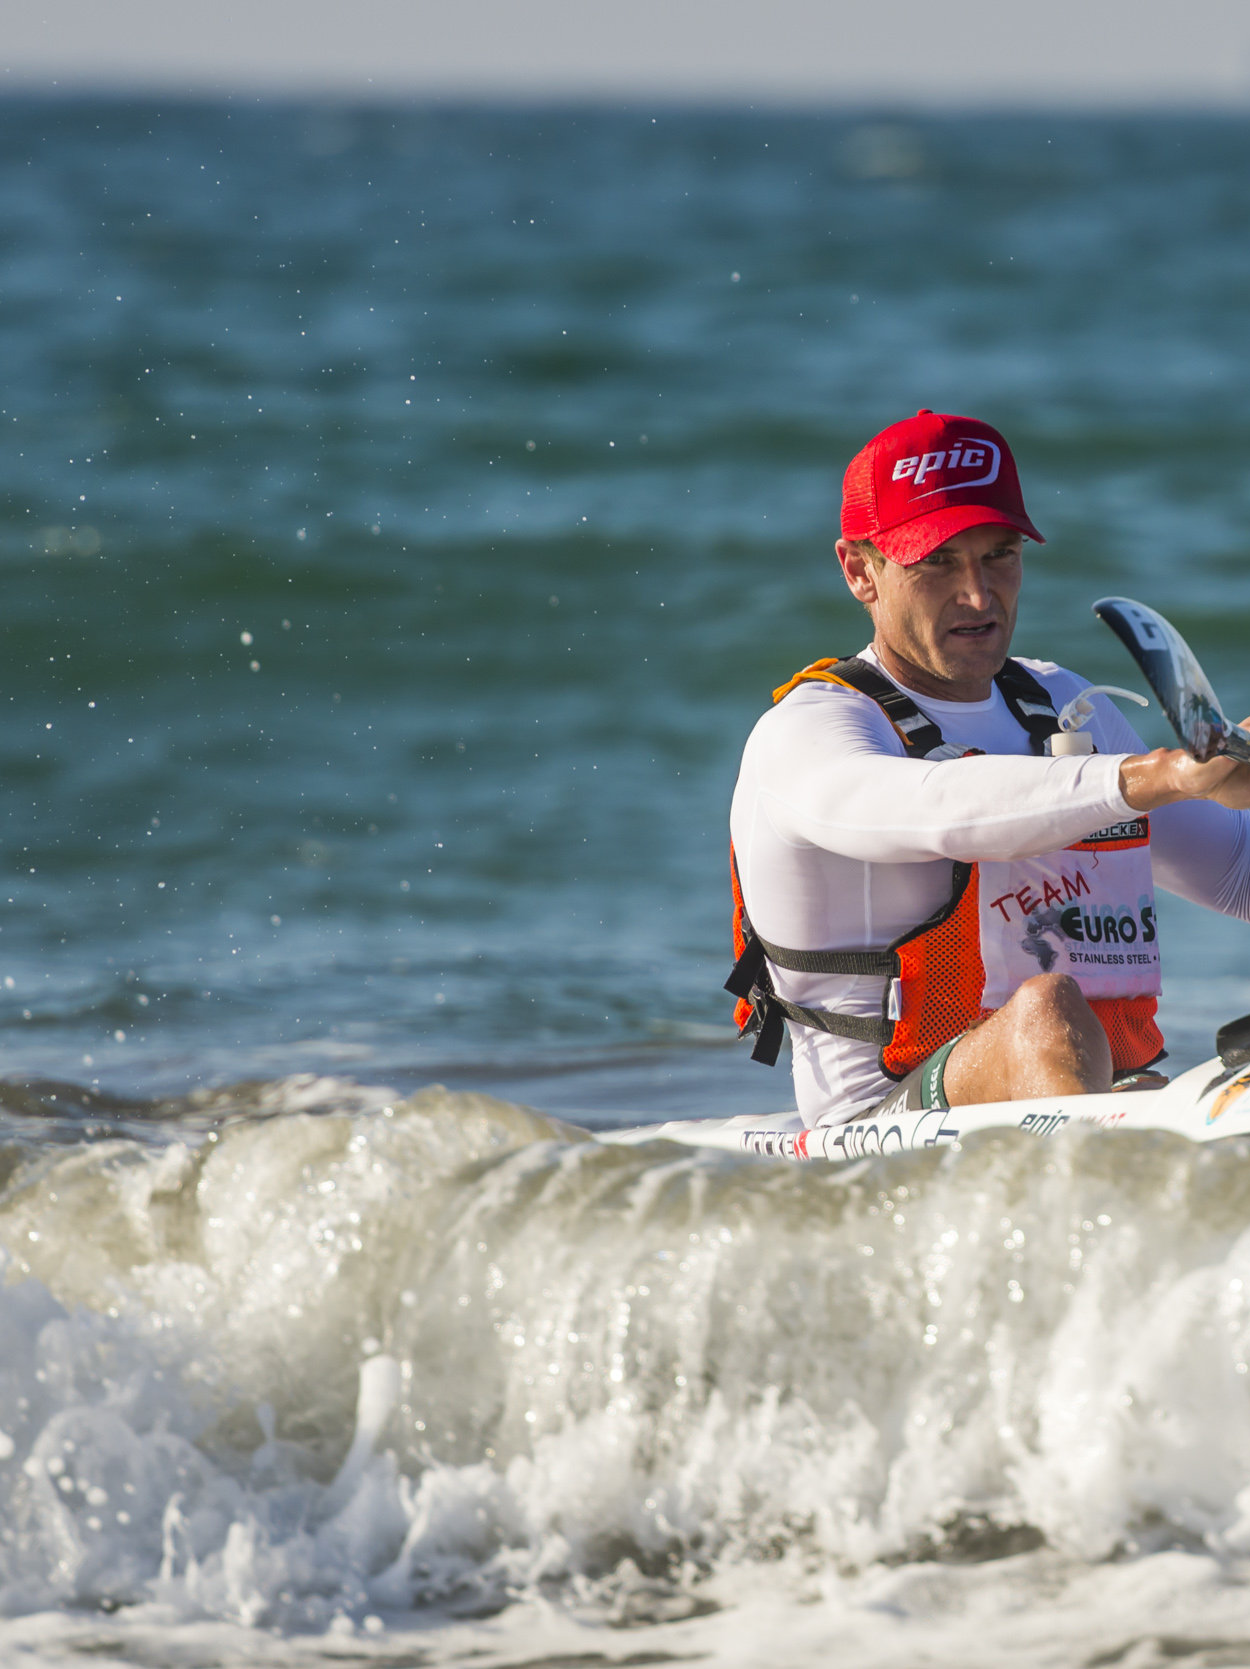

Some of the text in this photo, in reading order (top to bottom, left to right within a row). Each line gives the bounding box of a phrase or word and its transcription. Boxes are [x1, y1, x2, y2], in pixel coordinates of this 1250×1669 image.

[892, 443, 985, 485] epic
[990, 870, 1091, 923] TEAM
[1061, 906, 1137, 944] EURO
[1069, 952, 1152, 965] STAINLESS STEEL
